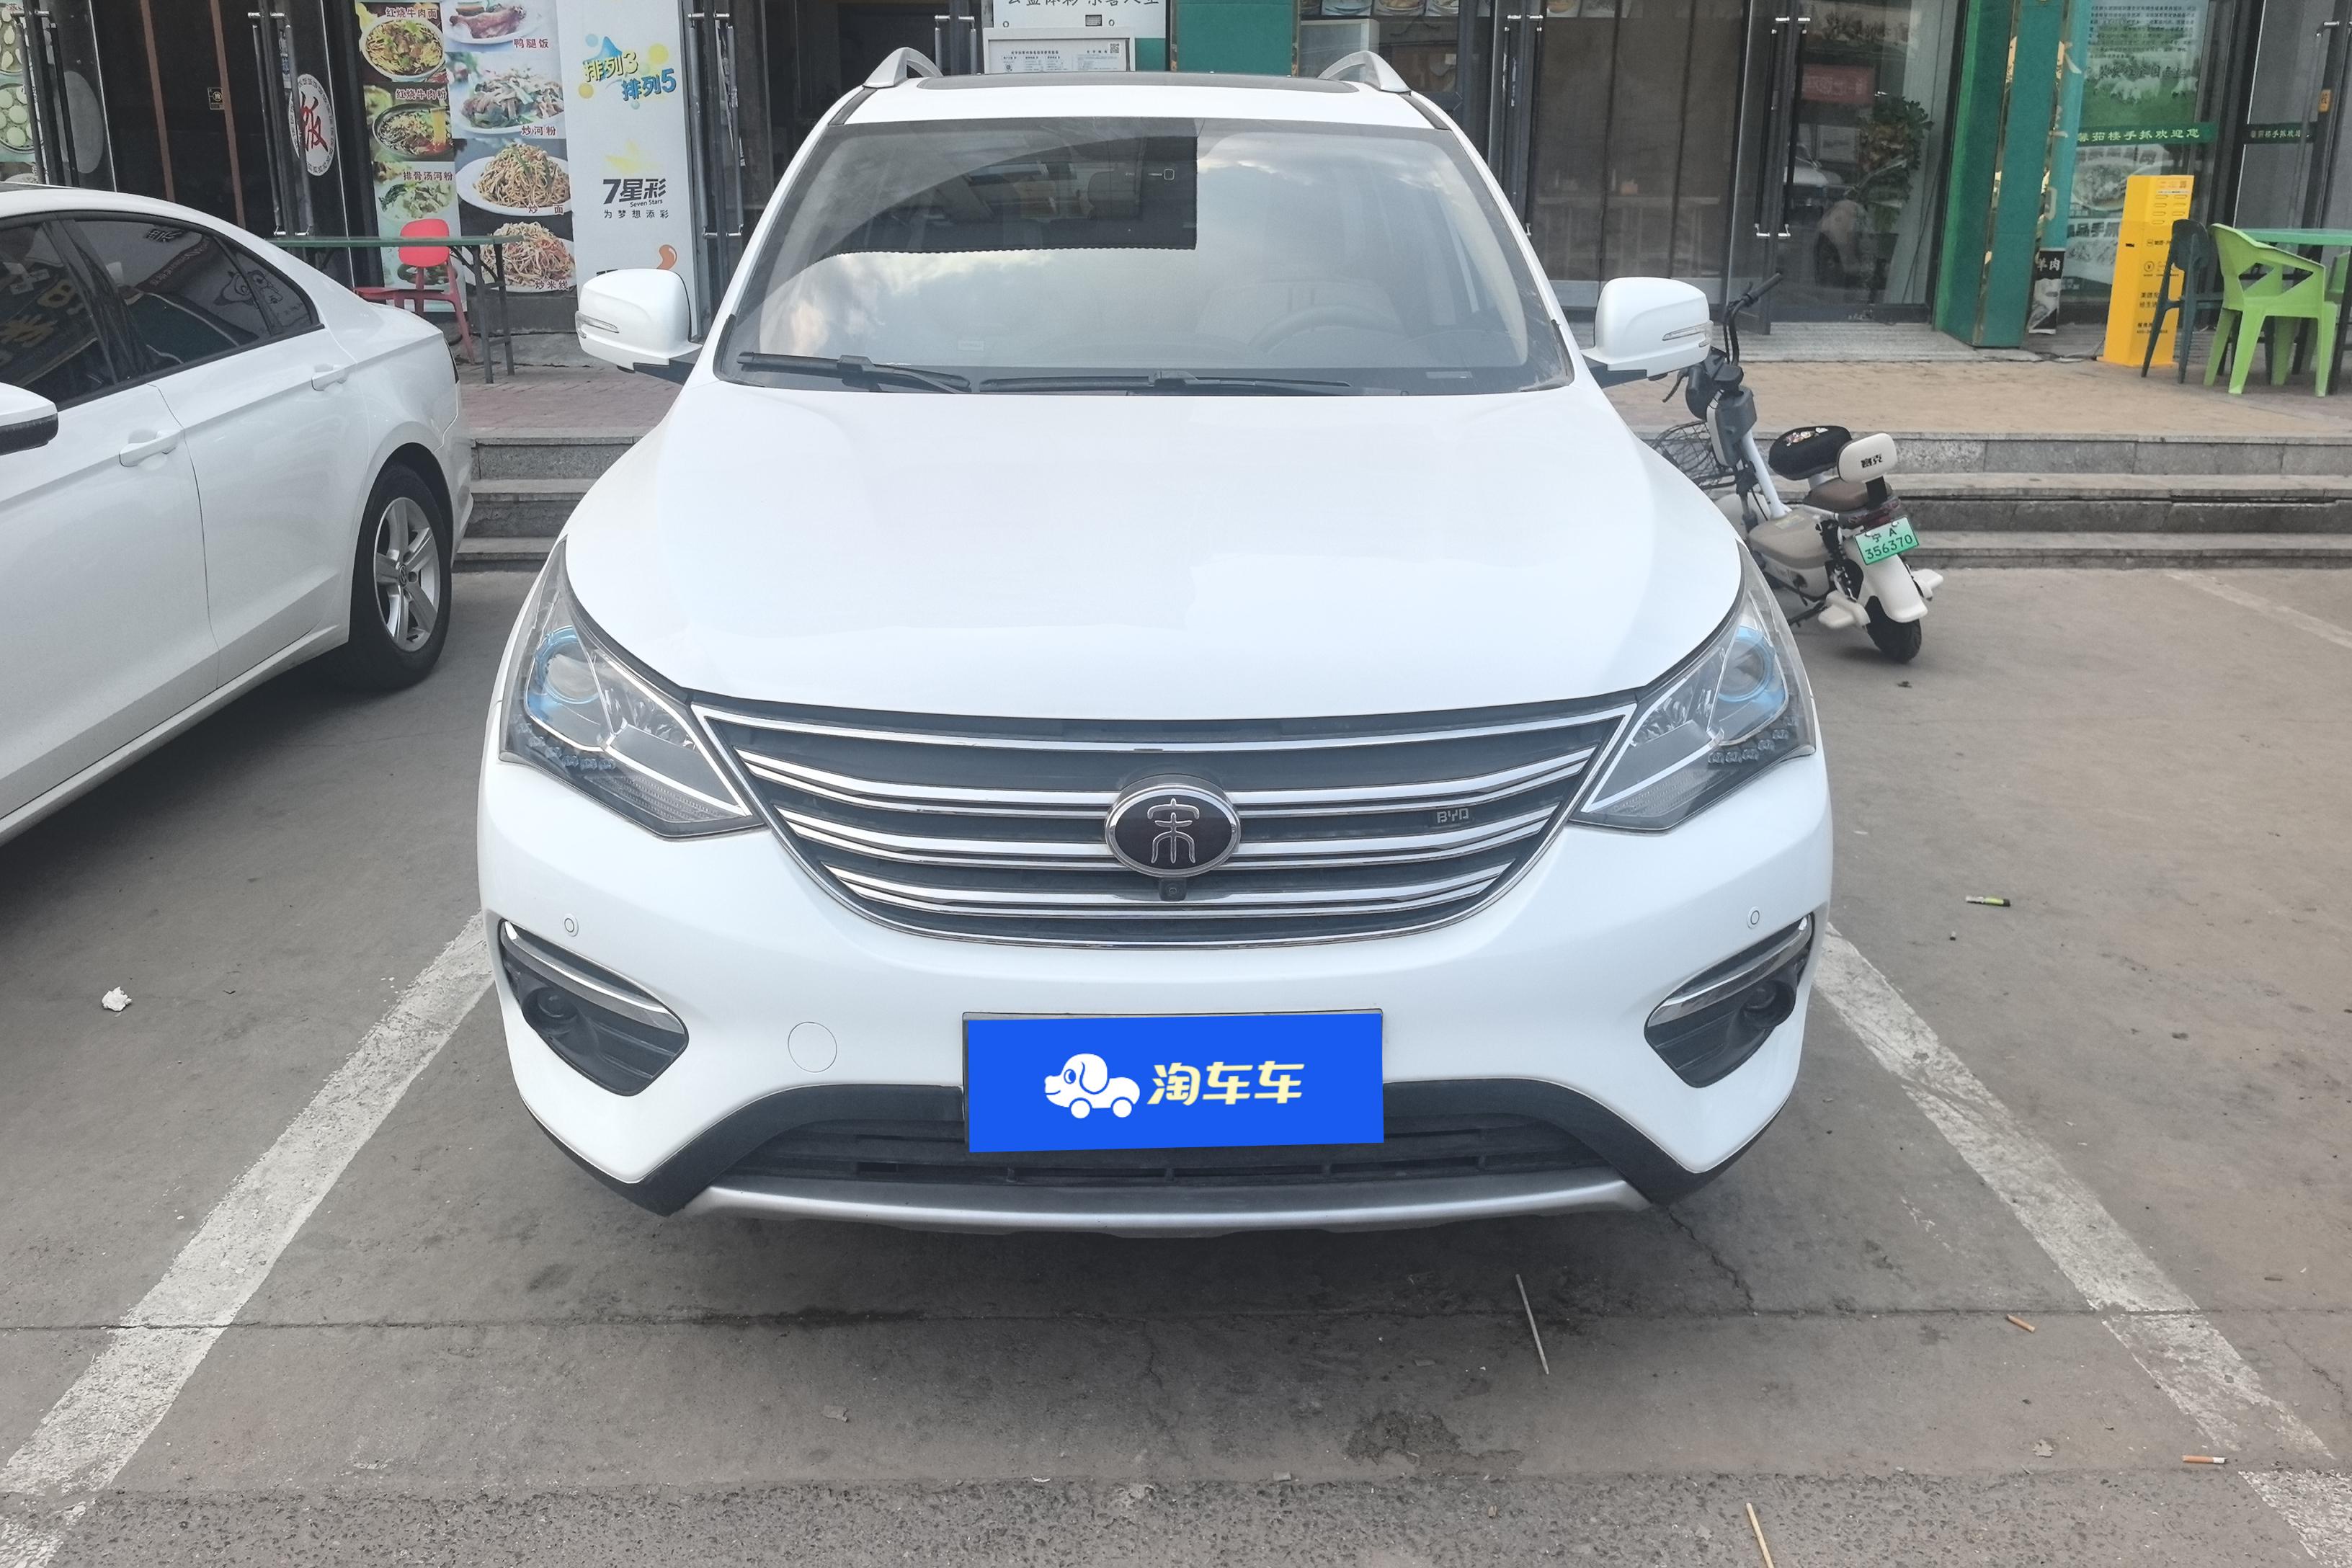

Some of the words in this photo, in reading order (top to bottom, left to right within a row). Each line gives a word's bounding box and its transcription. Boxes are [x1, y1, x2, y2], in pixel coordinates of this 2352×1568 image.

[386, 6, 438, 19] 红烧牛肉面
[513, 38, 549, 49] 鸭腿饭
[582, 52, 638, 82] 排列3
[621, 68, 677, 101] 排列5
[396, 88, 447, 100] 红烧牛肉粉
[520, 125, 556, 136] 炒河粉
[403, 171, 453, 181] 排骨汤河粉
[603, 179, 667, 205] 7星彩
[604, 209, 669, 219] 为梦想添彩
[535, 279, 569, 290] 炒米线
[1889, 527, 1897, 537] A
[1865, 534, 1913, 559] 356370
[1437, 807, 1469, 824] BYD
